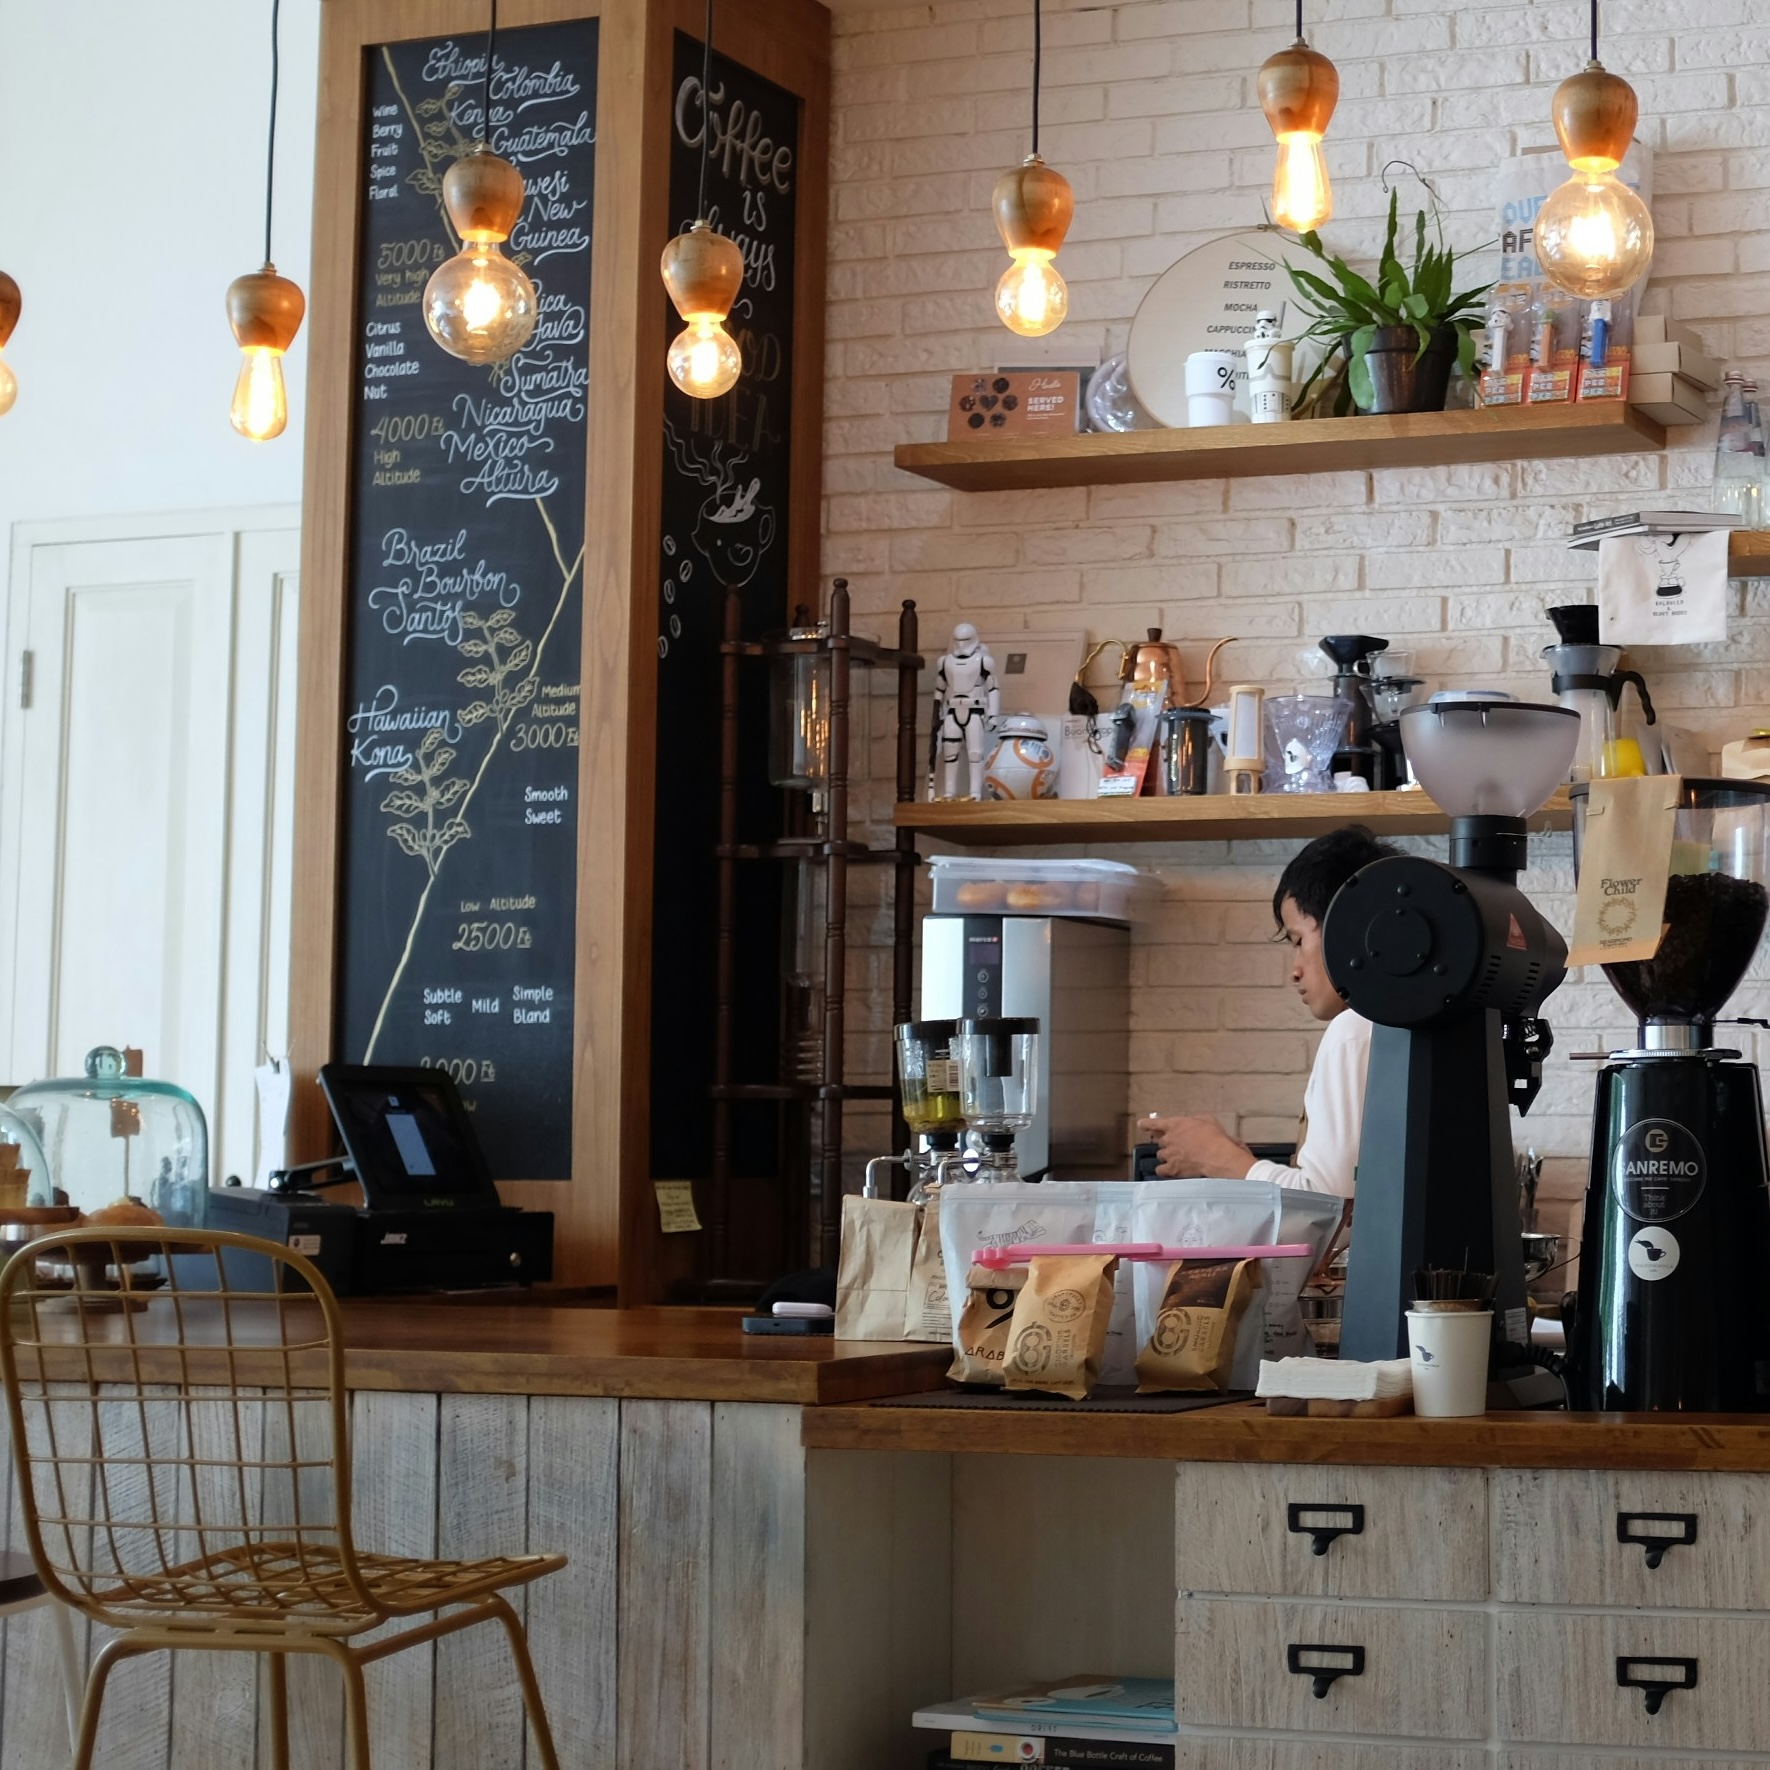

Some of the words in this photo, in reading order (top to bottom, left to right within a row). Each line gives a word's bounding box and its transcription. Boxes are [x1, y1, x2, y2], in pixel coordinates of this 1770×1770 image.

[489, 61, 580, 105] Colombia
[372, 123, 403, 138] Berry
[492, 111, 597, 157] Guatemala
[371, 144, 399, 157] Fruit
[370, 165, 396, 179] Spice
[369, 185, 398, 200] Floral
[528, 197, 587, 223] New
[510, 223, 589, 256] Guinea
[377, 239, 431, 268] 5000
[1228, 261, 1276, 271] ESPRESSO
[1223, 281, 1271, 290] RISTRETTO
[376, 291, 421, 307] Altitude
[1223, 303, 1258, 312] MOCHA
[366, 322, 401, 337] Citrus
[1206, 325, 1257, 334] CAPPUCCIN
[366, 341, 404, 358] Vanilla
[365, 361, 419, 378] Chocolate
[500, 351, 589, 400] Sumatra
[364, 385, 388, 400] Nut
[1028, 396, 1064, 405] SERVED
[453, 393, 584, 435] Nicaragua
[371, 414, 429, 444] 4000
[440, 431, 554, 464] Mexico
[374, 449, 401, 468] High
[373, 469, 420, 486] Altitude
[460, 460, 558, 502] Altura
[382, 528, 467, 571] Brazil
[413, 560, 520, 608] Bourbon
[368, 578, 463, 645] Santos
[347, 684, 462, 743] Hawaiian
[531, 702, 576, 717] Altitude
[510, 723, 566, 751] 3000
[351, 735, 412, 775] Kona
[524, 786, 568, 803] Smooth
[525, 808, 562, 825] Sweet
[1600, 878, 1643, 889] Flower
[1604, 883, 1637, 896] Child
[461, 900, 480, 913] Low
[489, 895, 536, 910] Altitude
[452, 922, 516, 951] 2500
[423, 987, 462, 1004] Subtle
[512, 985, 553, 1003] Simple
[472, 997, 500, 1014] Mild
[424, 1010, 451, 1025] Soft
[513, 1009, 550, 1024] Bland
[1622, 1160, 1698, 1176] ANREMO
[1054, 1748, 1067, 1757] The
[1069, 1749, 1085, 1758] Blue
[1087, 1750, 1108, 1760] Bottle
[1110, 1751, 1128, 1761] Craft
[1130, 1752, 1138, 1761] of
[1139, 1752, 1163, 1763] Coffee
